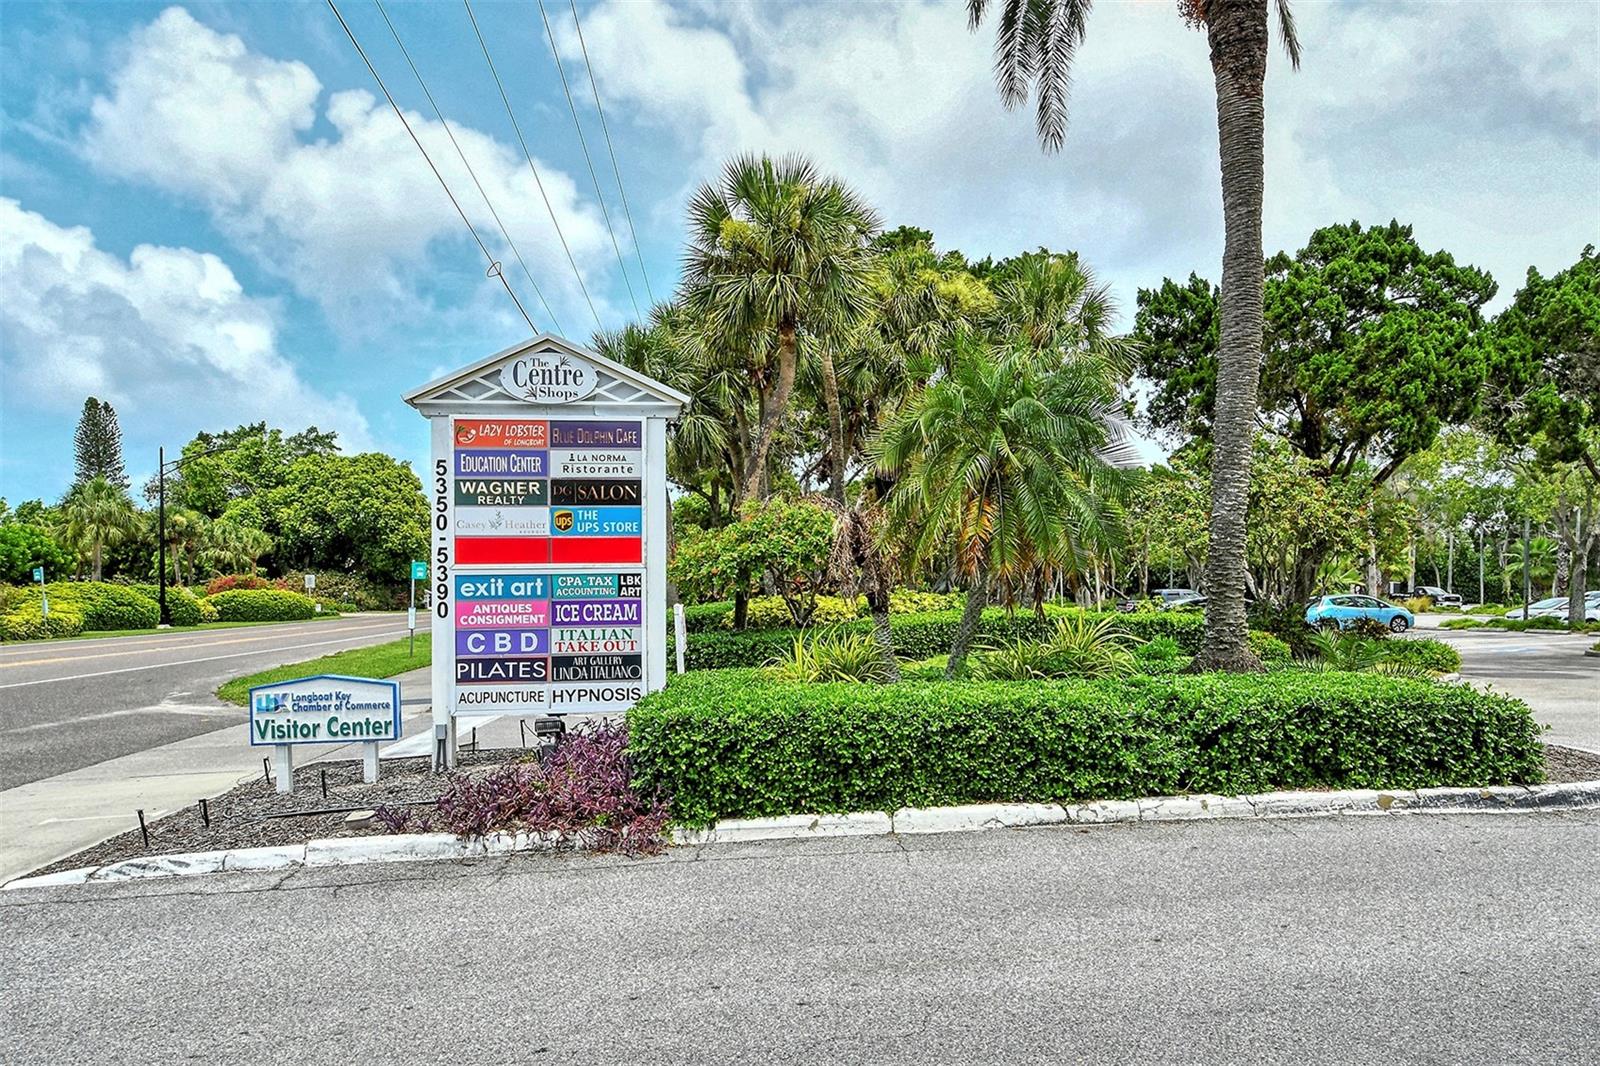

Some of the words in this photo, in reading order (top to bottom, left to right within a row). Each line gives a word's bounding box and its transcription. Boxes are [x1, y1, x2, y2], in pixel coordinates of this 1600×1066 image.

[530, 358, 549, 367] The
[512, 360, 584, 388] Centre
[538, 386, 579, 400] Shops
[479, 424, 503, 437] LAZY
[505, 424, 545, 438] LOBSTER
[552, 428, 574, 444] BLUE
[577, 428, 614, 444] DOLPHIN
[616, 428, 637, 444] CAFE
[503, 438, 513, 446] OF
[513, 438, 544, 446] LONGBOAT
[460, 453, 508, 473] EDUCATION
[510, 453, 542, 473] CENTER
[577, 454, 588, 462] LA
[591, 454, 627, 462] NORMA
[562, 464, 634, 474] Ristorante
[459, 481, 541, 495] WAGNER
[577, 484, 638, 500] SALON
[477, 495, 526, 505] REALTY
[577, 510, 598, 520] THE
[456, 519, 487, 531] Casey
[505, 519, 546, 529] Heather
[555, 516, 573, 528] ups
[577, 522, 600, 532] UPS
[603, 522, 638, 532] STORE
[435, 459, 449, 619] 5350-5390
[620, 575, 641, 585] LBK
[460, 578, 504, 597] exit
[511, 578, 543, 596] art
[556, 587, 616, 596] ACCOUNTING
[620, 587, 641, 596] ART
[473, 603, 533, 614] ANTIQUES
[555, 605, 580, 622] ICE
[583, 604, 638, 622] CREAM
[460, 614, 545, 625] CONSIGNMENT
[559, 628, 634, 641] ITALIAN
[555, 640, 601, 652] TAKE
[604, 640, 637, 651] OUT
[573, 656, 587, 665] ART
[590, 656, 623, 665] GALLERY
[457, 661, 546, 679] PILATES
[553, 666, 588, 680] LINDA
[590, 664, 642, 680] ITALIANO
[291, 692, 333, 704] Longboat
[335, 691, 352, 703] Key
[458, 690, 544, 704] ACUPUNCTURE
[552, 687, 642, 704] HYPNOSIS
[291, 702, 331, 713] Chamber
[335, 702, 343, 711] of
[345, 701, 391, 711] Commerce
[255, 718, 320, 739] Visitor
[326, 716, 392, 737] Center
